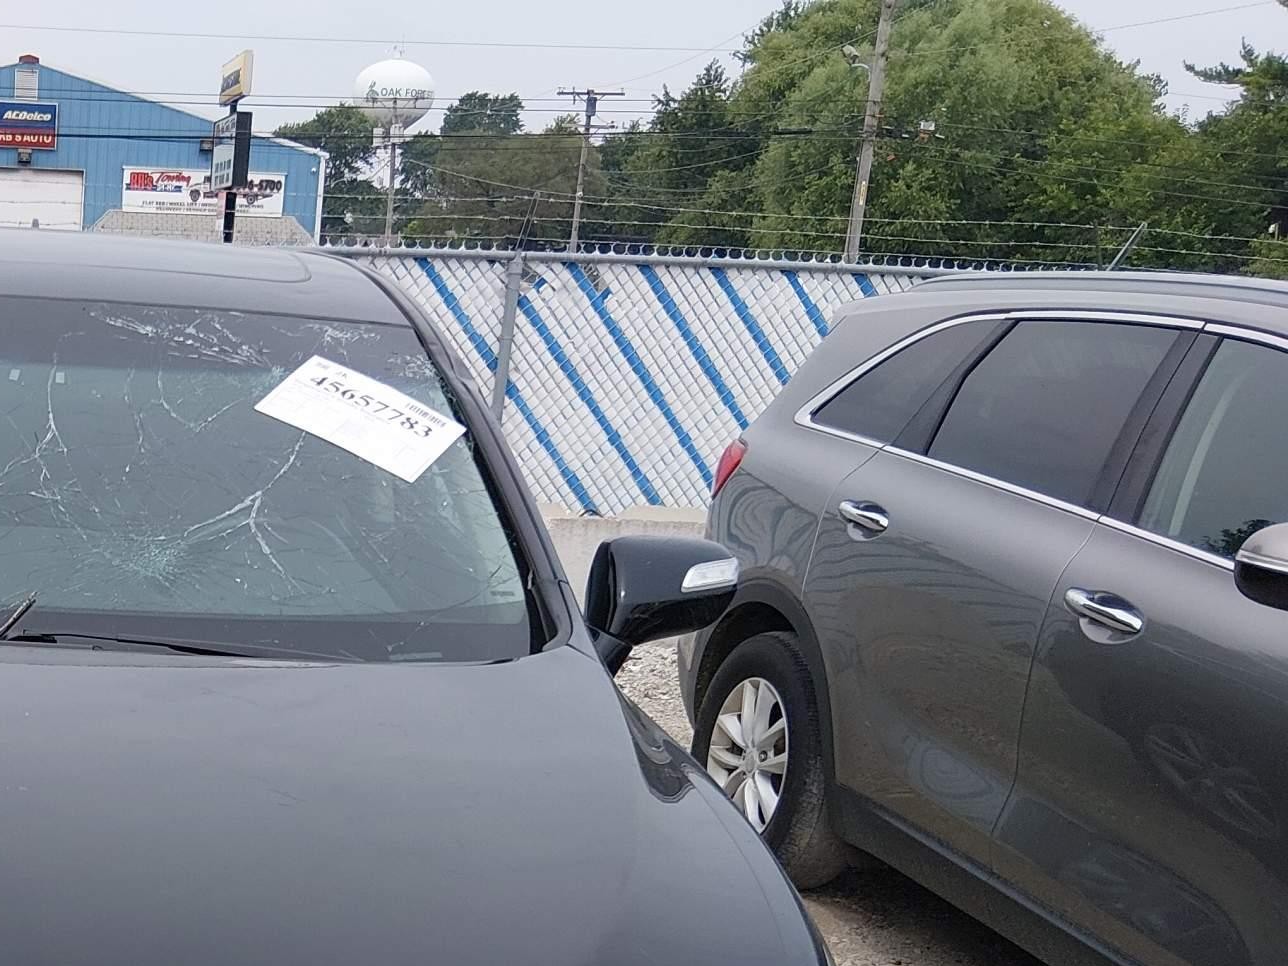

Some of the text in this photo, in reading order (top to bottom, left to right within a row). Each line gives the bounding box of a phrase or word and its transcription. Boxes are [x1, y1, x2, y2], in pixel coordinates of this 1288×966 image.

[380, 87, 402, 97] OAK
[151, 171, 192, 187] Towing
[309, 375, 433, 438] 45657783
